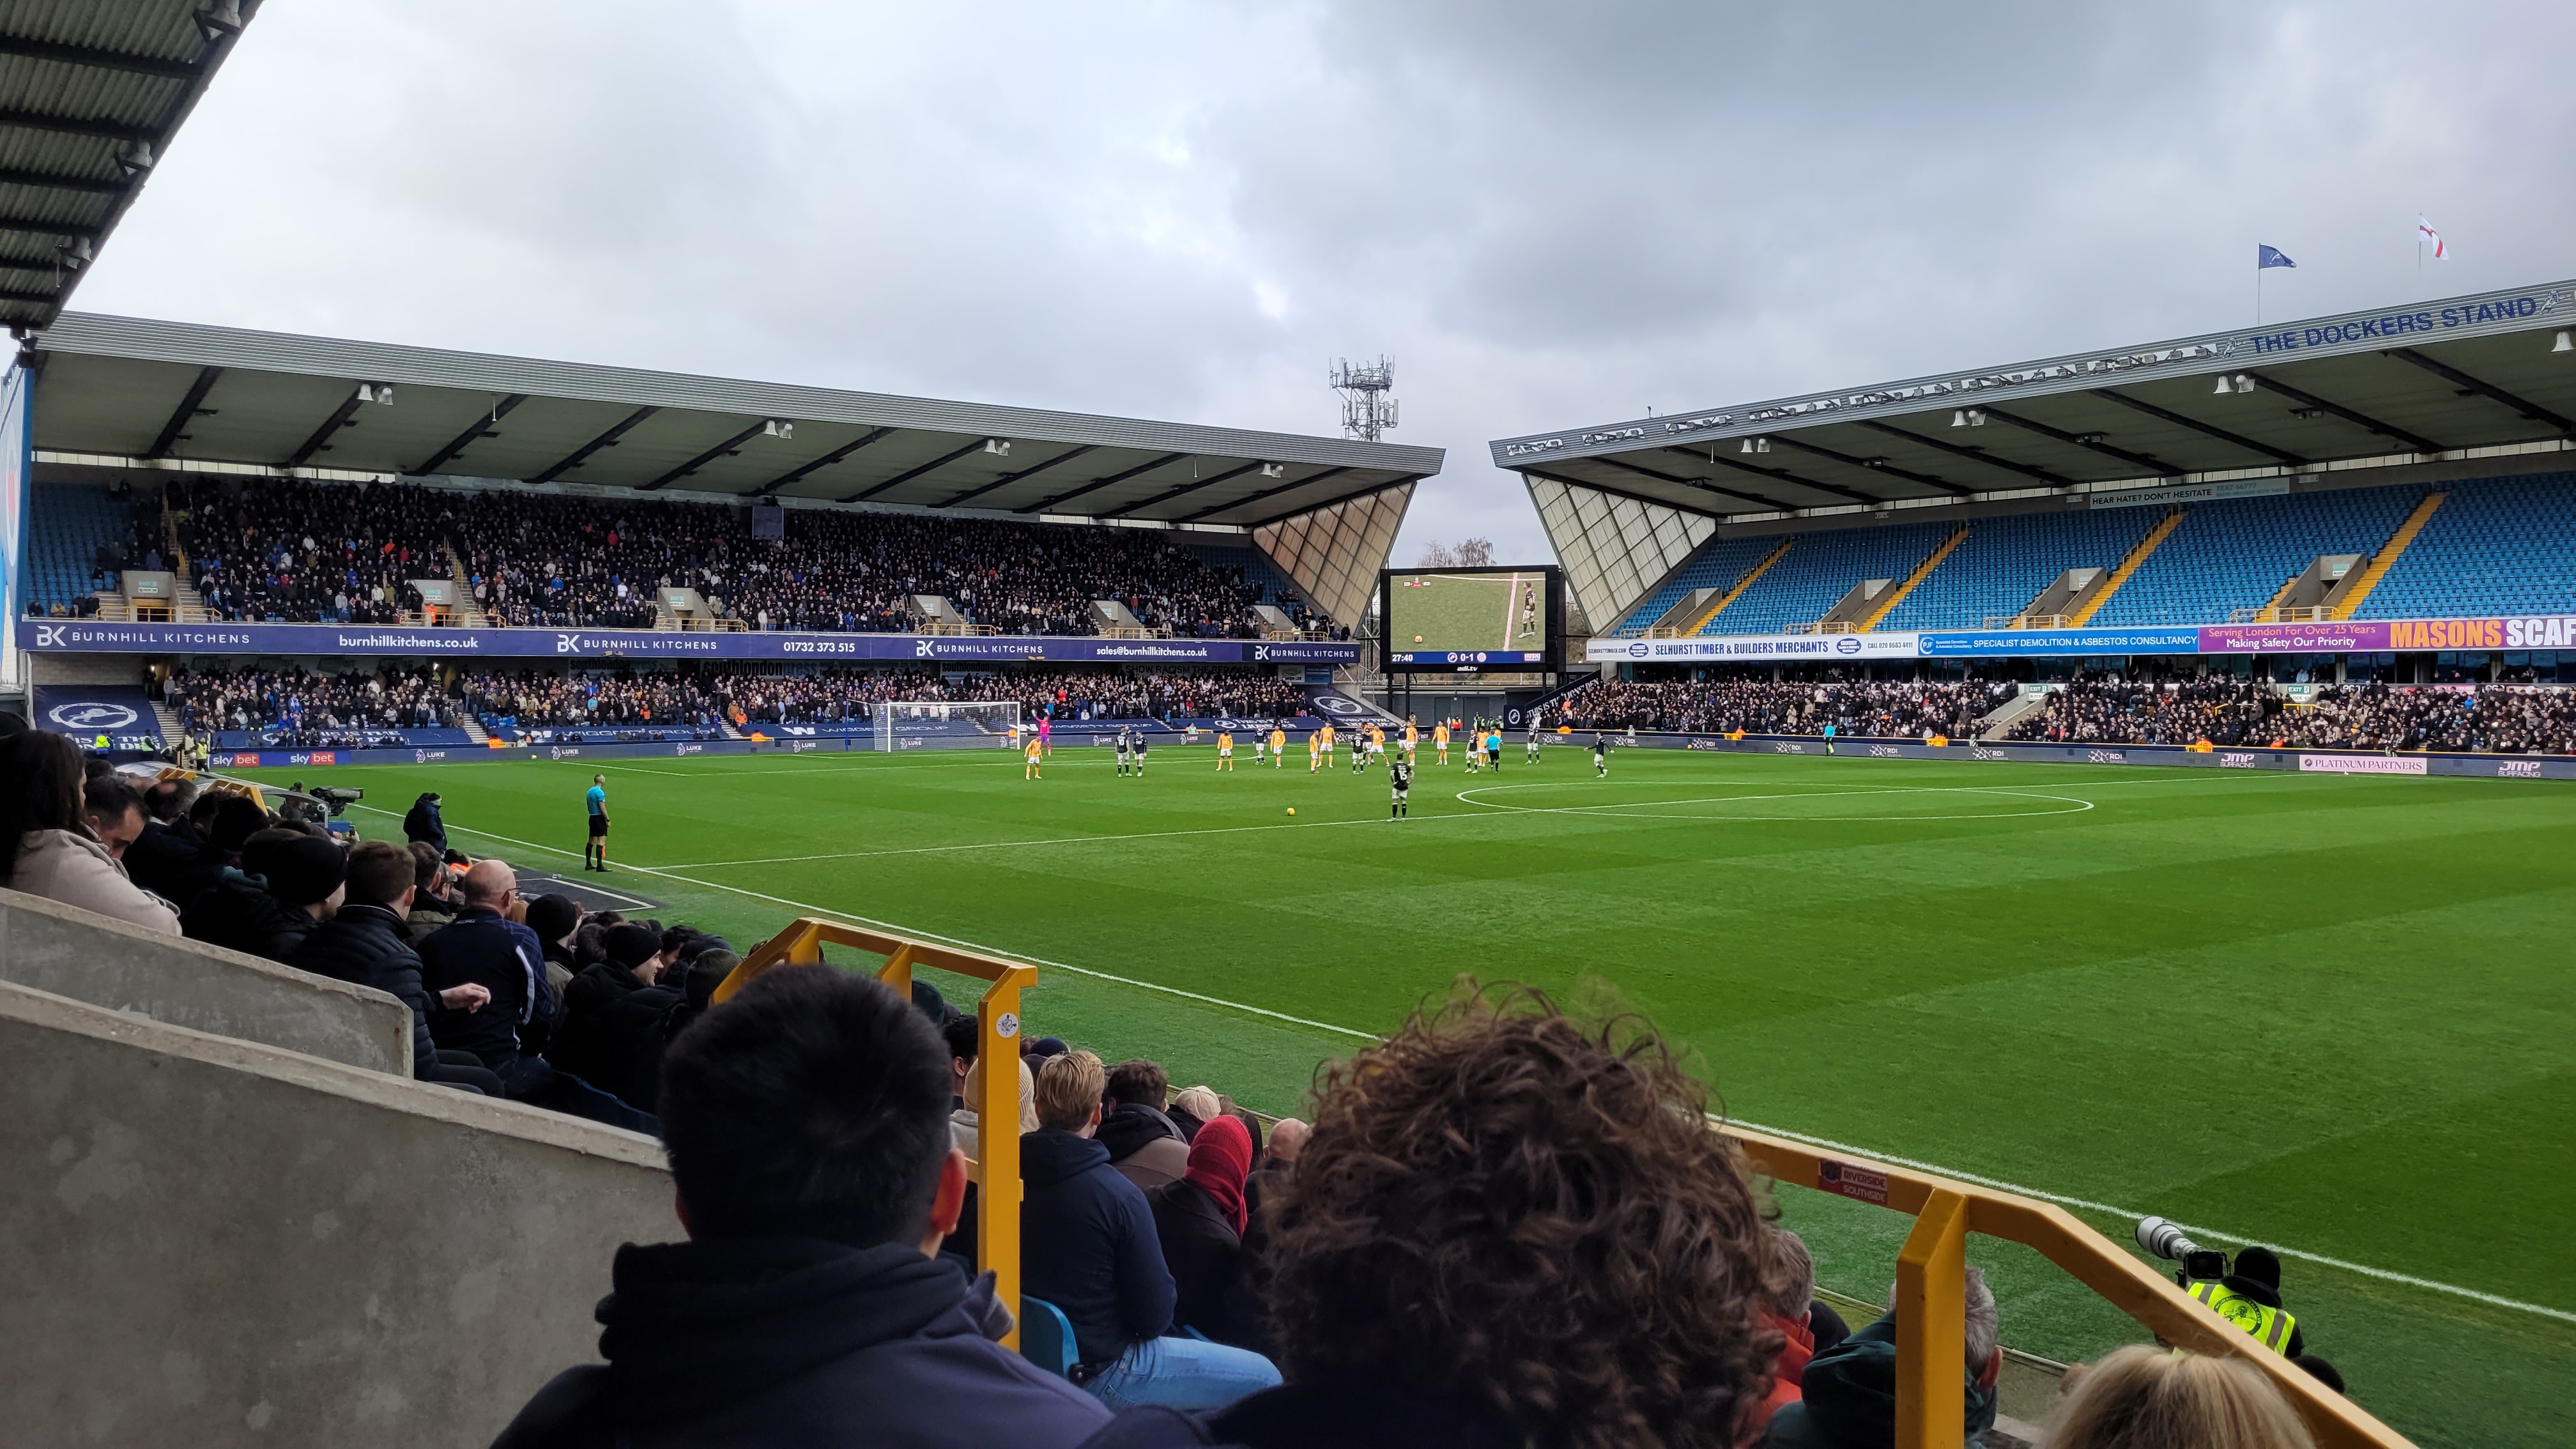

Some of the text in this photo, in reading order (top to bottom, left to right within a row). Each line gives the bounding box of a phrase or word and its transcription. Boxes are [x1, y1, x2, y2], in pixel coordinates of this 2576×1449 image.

[2250, 298, 2536, 353] THE DOCKERS STAND
[2117, 494, 2142, 503] HATE?
[2144, 492, 2172, 501] DON'T
[2173, 488, 2212, 498] HESITATE
[72, 632, 157, 642] BURNHILL
[165, 633, 250, 643] KITCHENS
[2209, 625, 2375, 638] Serving London For Over 25 Years
[2390, 620, 2501, 647] MASONS
[339, 634, 479, 648] burnhillkitchens.co.uk
[584, 640, 648, 648] BURNHILL
[653, 641, 717, 650] KITCHENS
[2020, 638, 2071, 647] DEMOLITION
[2130, 636, 2197, 645] CONSULTANCY
[2227, 637, 2356, 650] Making Safety Our Priority
[784, 642, 855, 653] 01732 373 515
[937, 645, 988, 653] BURNHILL
[1096, 646, 1208, 657] sales@burnhillkitchens.co.uk
[1655, 644, 1693, 655] SELHURST
[1695, 643, 1724, 654] TIMBER
[1727, 645, 1732, 654] &
[1734, 643, 1774, 654] BUILDERS
[1775, 641, 1828, 653] MERCHANTS
[1126, 665, 1150, 673] SHOW
[1156, 665, 1190, 673] RACISM
[1585, 678, 1599, 692] DEN
[213, 755, 257, 767] sky bet
[290, 753, 332, 765] sky bet
[2221, 754, 2255, 762] JMP
[2315, 759, 2422, 770] PLATINUM PARTNERS
[2499, 762, 2540, 771] JMP
[1399, 770, 1407, 780] 15
[1844, 1170, 1885, 1188] RIVERSIDE
[1843, 1184, 1885, 1202] SOUTHSIDE
